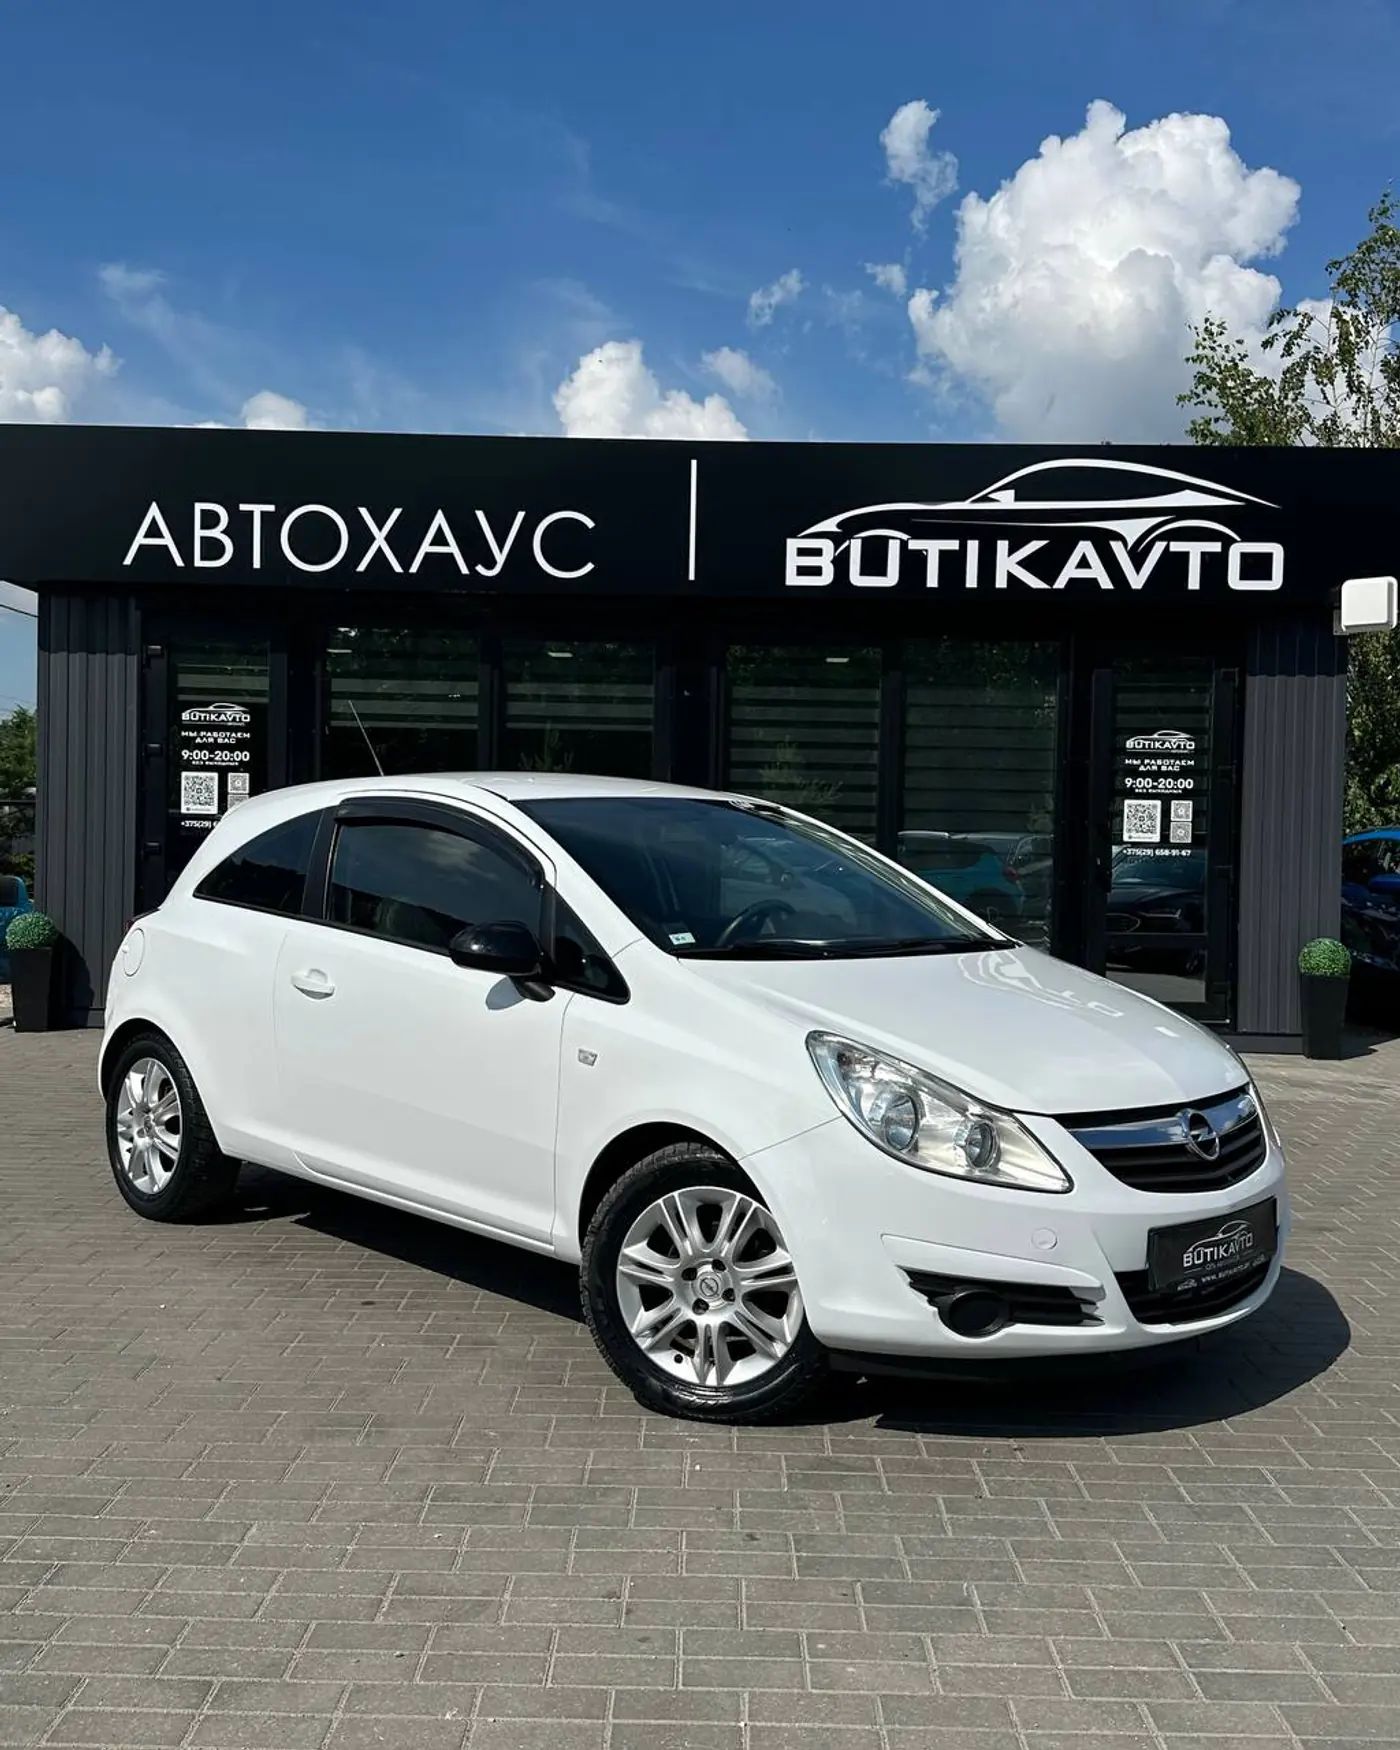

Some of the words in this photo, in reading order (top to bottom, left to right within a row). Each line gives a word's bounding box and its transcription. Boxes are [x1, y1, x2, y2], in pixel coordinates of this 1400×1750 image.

[122, 500, 597, 579] АВТОХАУС
[785, 538, 1285, 591] BUTIKAVTO
[181, 712, 251, 722] BUTIKAVTO
[1125, 740, 1195, 749] BUTIKAVTO
[181, 750, 250, 761] 9:00-20:00
[1124, 778, 1194, 789] 9:00-20:00
[1183, 1232, 1254, 1268] BUTIKAVTO
